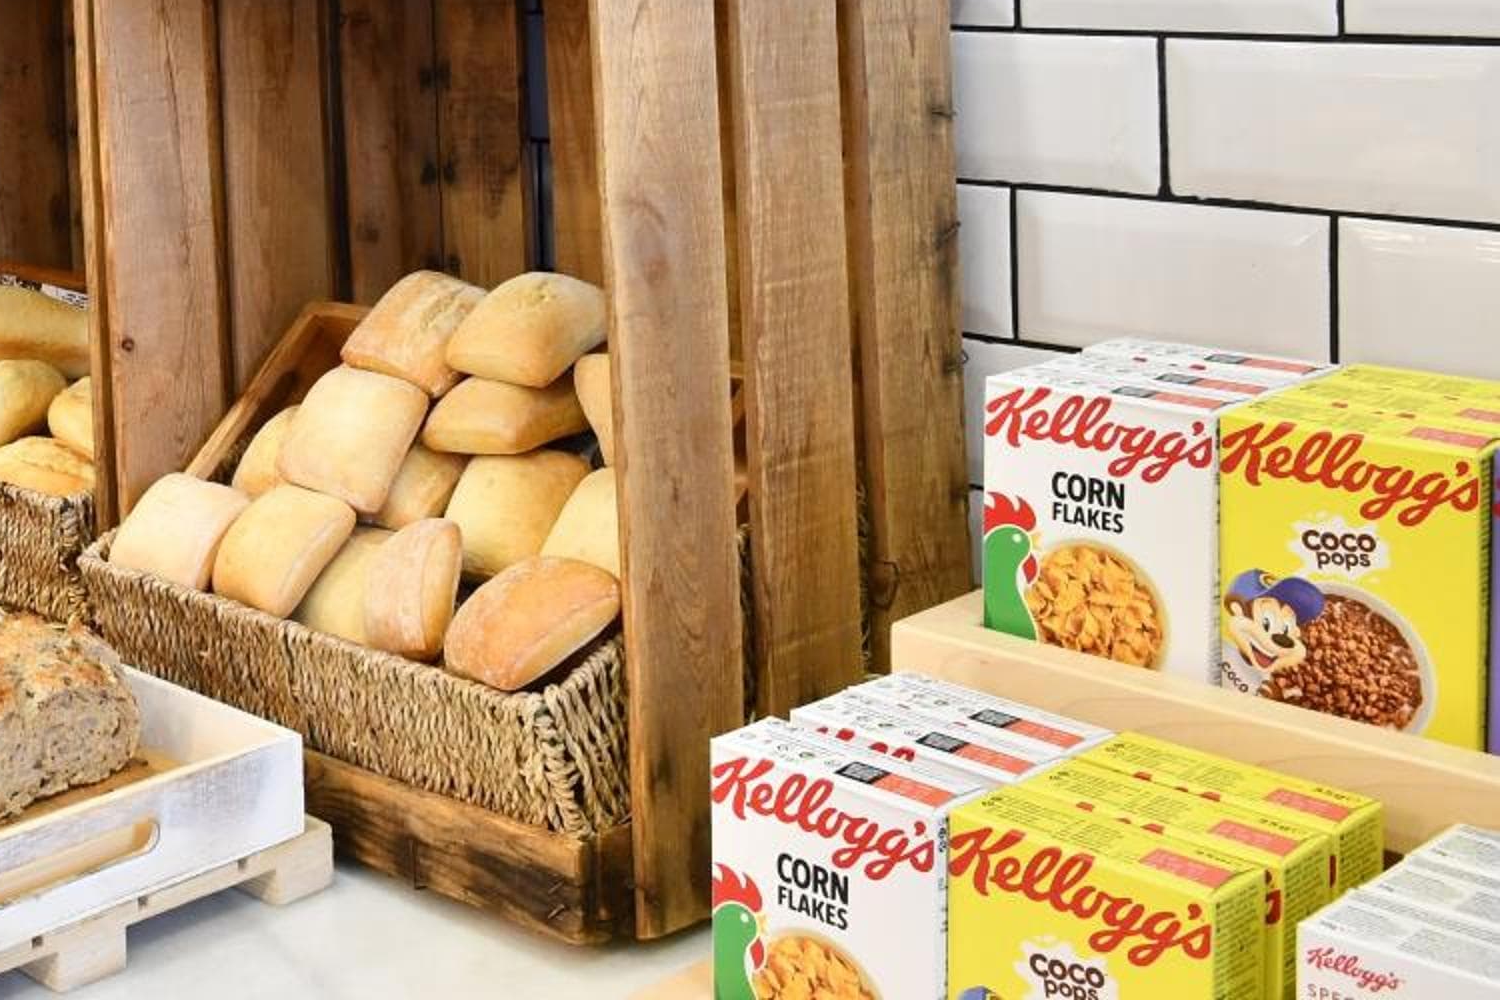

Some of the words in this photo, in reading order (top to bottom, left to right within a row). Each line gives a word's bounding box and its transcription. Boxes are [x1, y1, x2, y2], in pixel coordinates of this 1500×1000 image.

[985, 387, 1213, 483] Kellogg's
[1051, 470, 1125, 511] CORN
[1219, 422, 1479, 527] Kellogg's
[1052, 502, 1124, 533] FLAKES
[1316, 551, 1370, 570] pops
[711, 757, 935, 880] Kellogg's
[777, 853, 849, 906] CORN
[948, 826, 1212, 967] Kellogg's
[777, 886, 848, 931] FLAKES
[1307, 946, 1402, 992] Kellogg's
